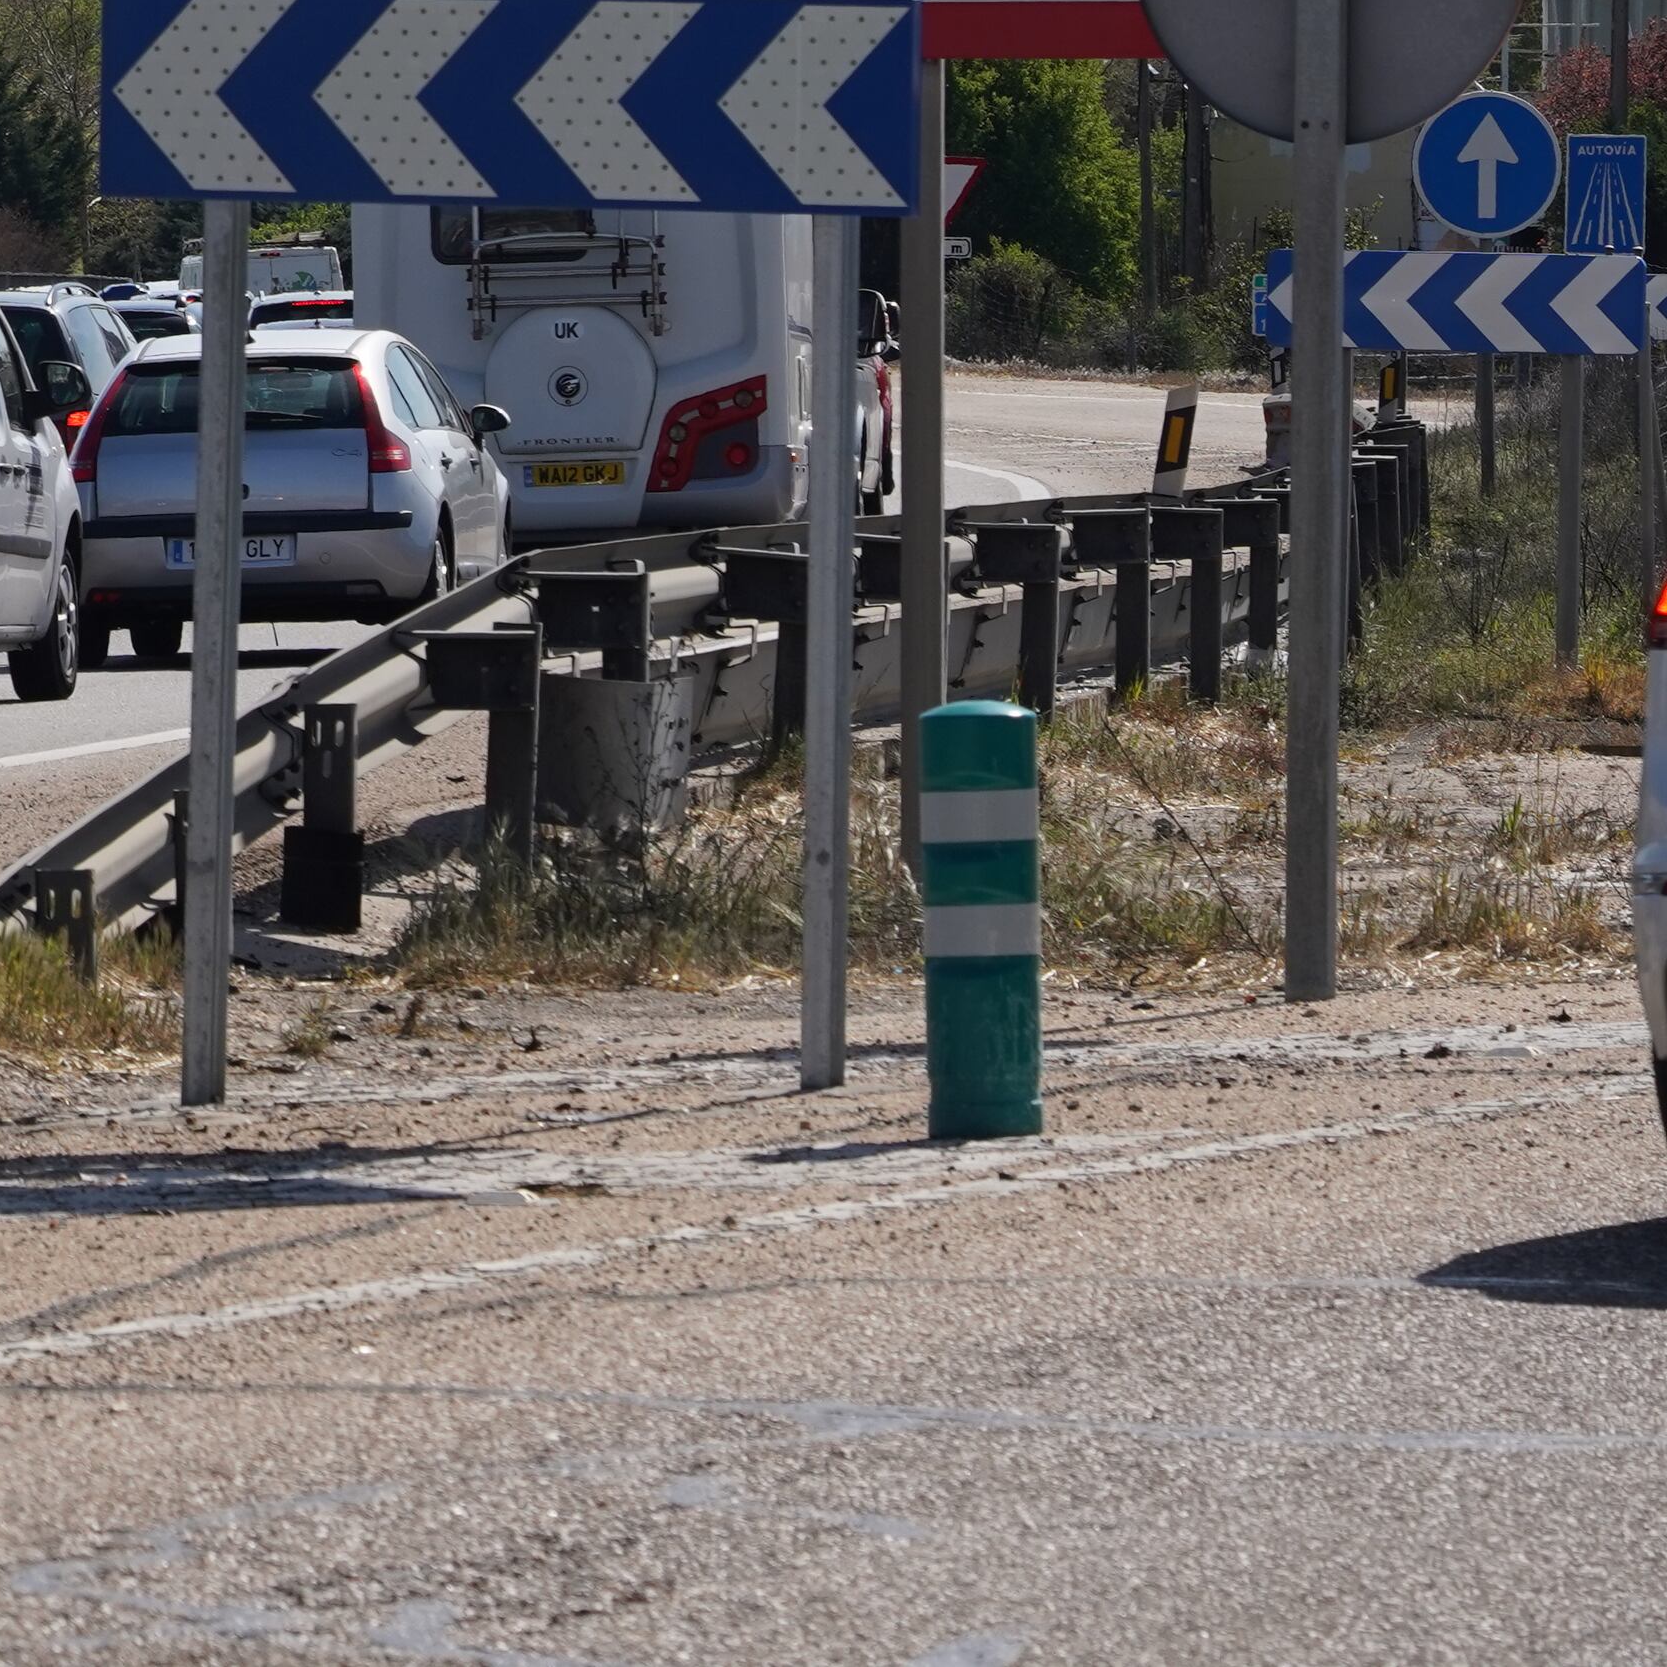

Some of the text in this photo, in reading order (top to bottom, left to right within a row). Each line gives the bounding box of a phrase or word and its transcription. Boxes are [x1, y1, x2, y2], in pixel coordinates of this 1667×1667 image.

[1578, 141, 1636, 155] AUTOVÍA
[554, 322, 579, 339] UK
[522, 436, 616, 446] FRONTIER
[538, 466, 578, 484] WA12
[246, 539, 284, 558] GLY
